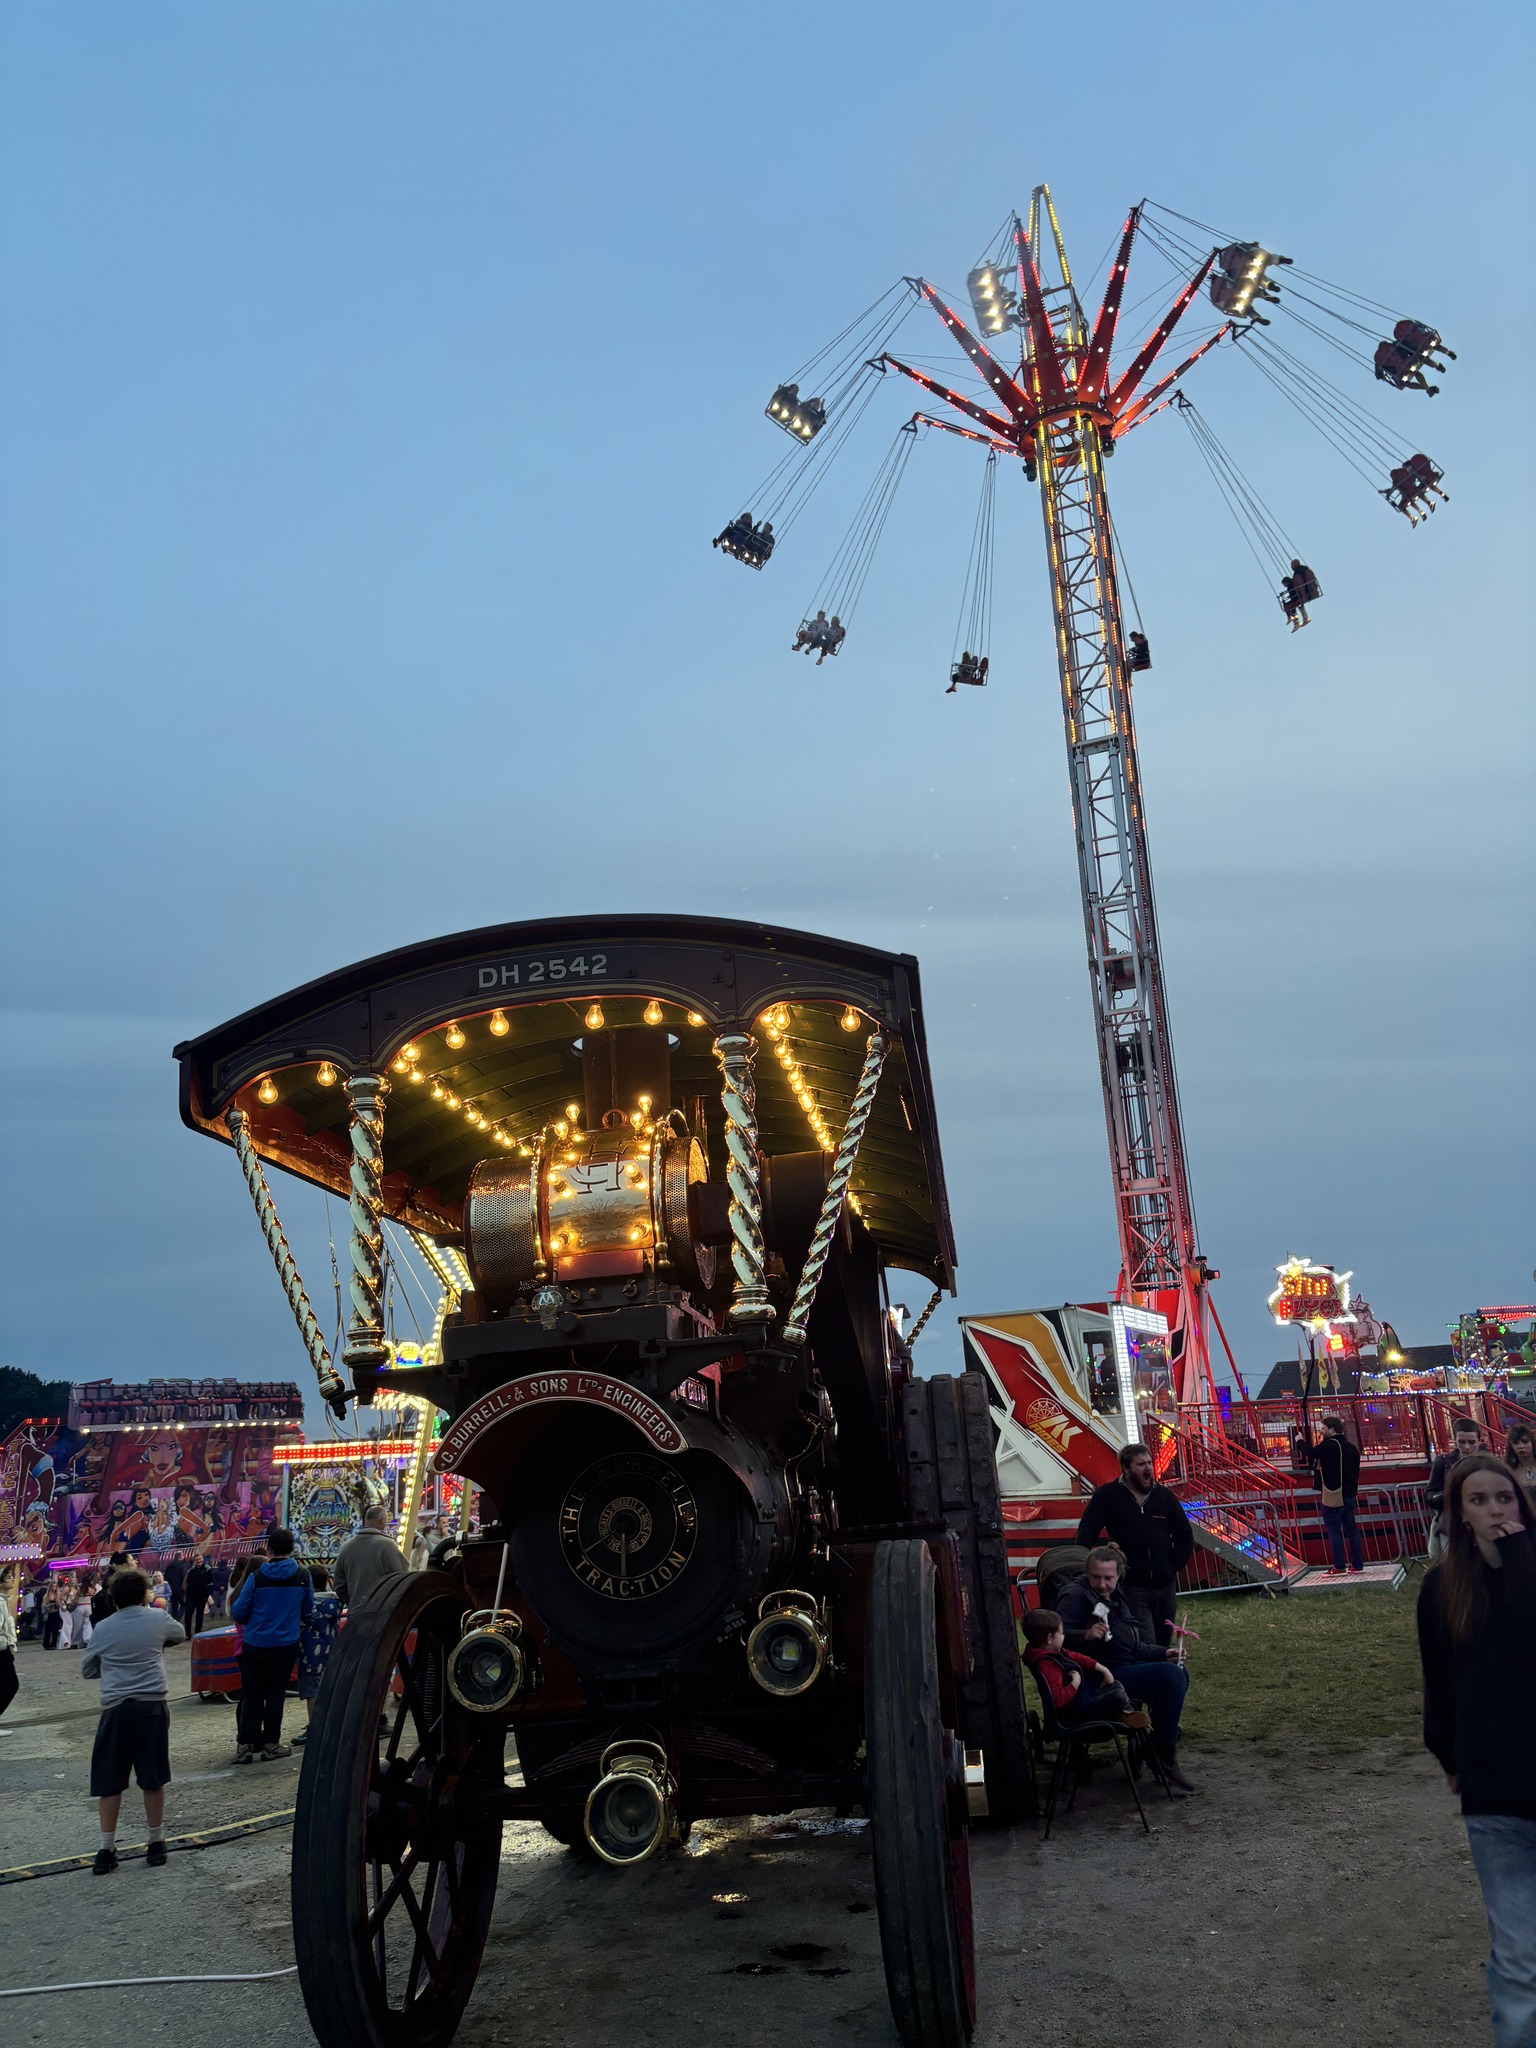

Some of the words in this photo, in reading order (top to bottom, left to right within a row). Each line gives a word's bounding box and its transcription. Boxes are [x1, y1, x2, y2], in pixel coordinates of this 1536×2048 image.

[478, 964, 519, 988] DH
[528, 954, 608, 982] 2542
[1281, 1273, 1337, 1297] STAR
[1279, 1298, 1349, 1321] FLYER
[514, 1387, 525, 1402] &
[530, 1378, 569, 1396] SONS
[603, 1384, 673, 1443] ENGINEERS
[1027, 1423, 1067, 1454] RIDES
[562, 1489, 587, 1540] THE
[575, 1550, 687, 1596] TRACTION
